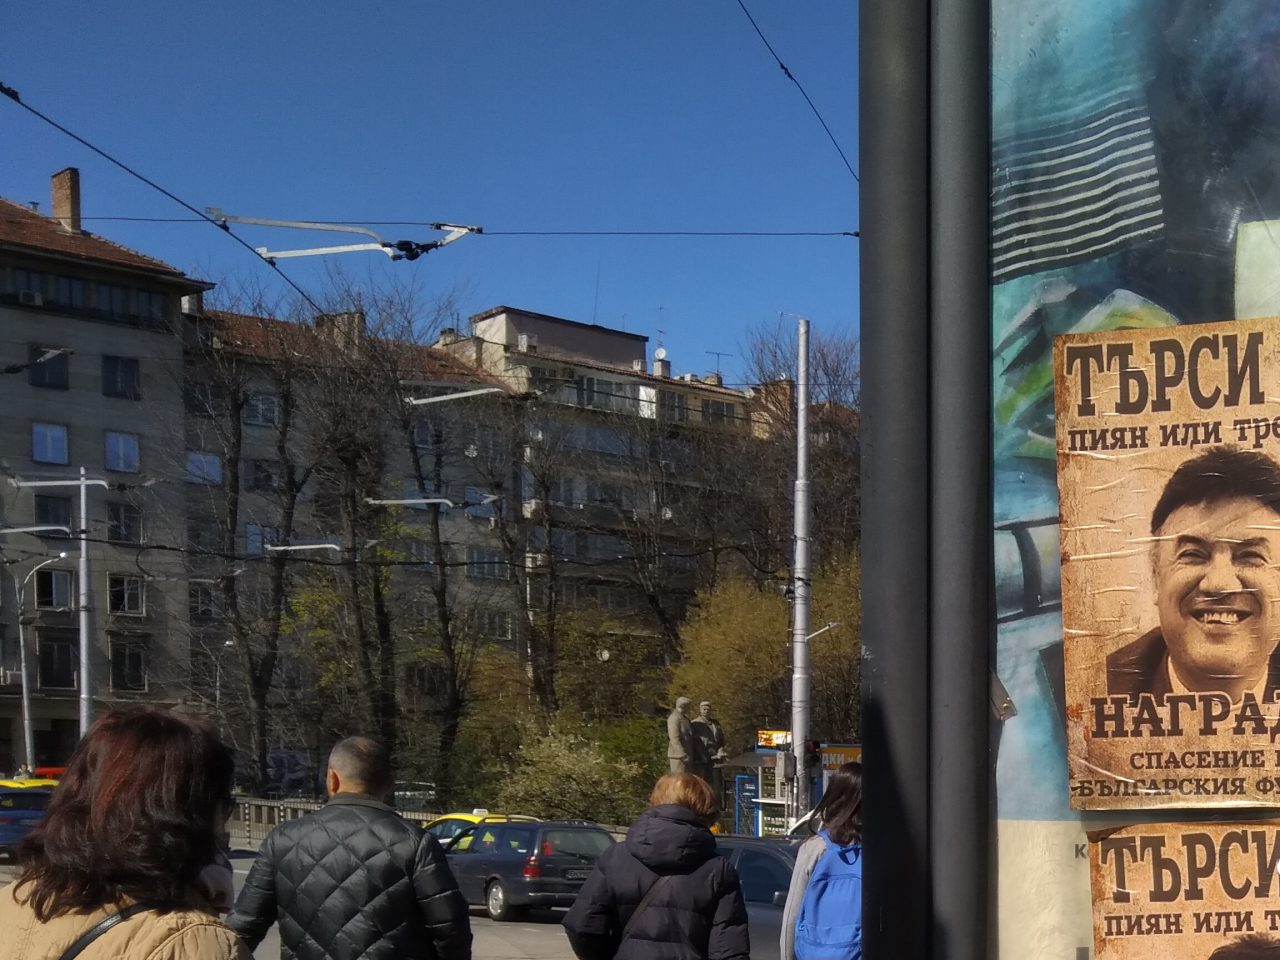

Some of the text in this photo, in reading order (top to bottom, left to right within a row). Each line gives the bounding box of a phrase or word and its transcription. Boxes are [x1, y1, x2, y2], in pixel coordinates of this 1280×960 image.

[1066, 331, 1265, 417] ТЪРСИ
[1068, 425, 1149, 452] пиян
[1159, 420, 1223, 447] или
[1129, 750, 1266, 770] СПАСЕНИЕ
[1078, 777, 1247, 798] БЪЛГАРСКИЯ
[1104, 912, 1184, 937] пиян
[1193, 910, 1255, 935] или
